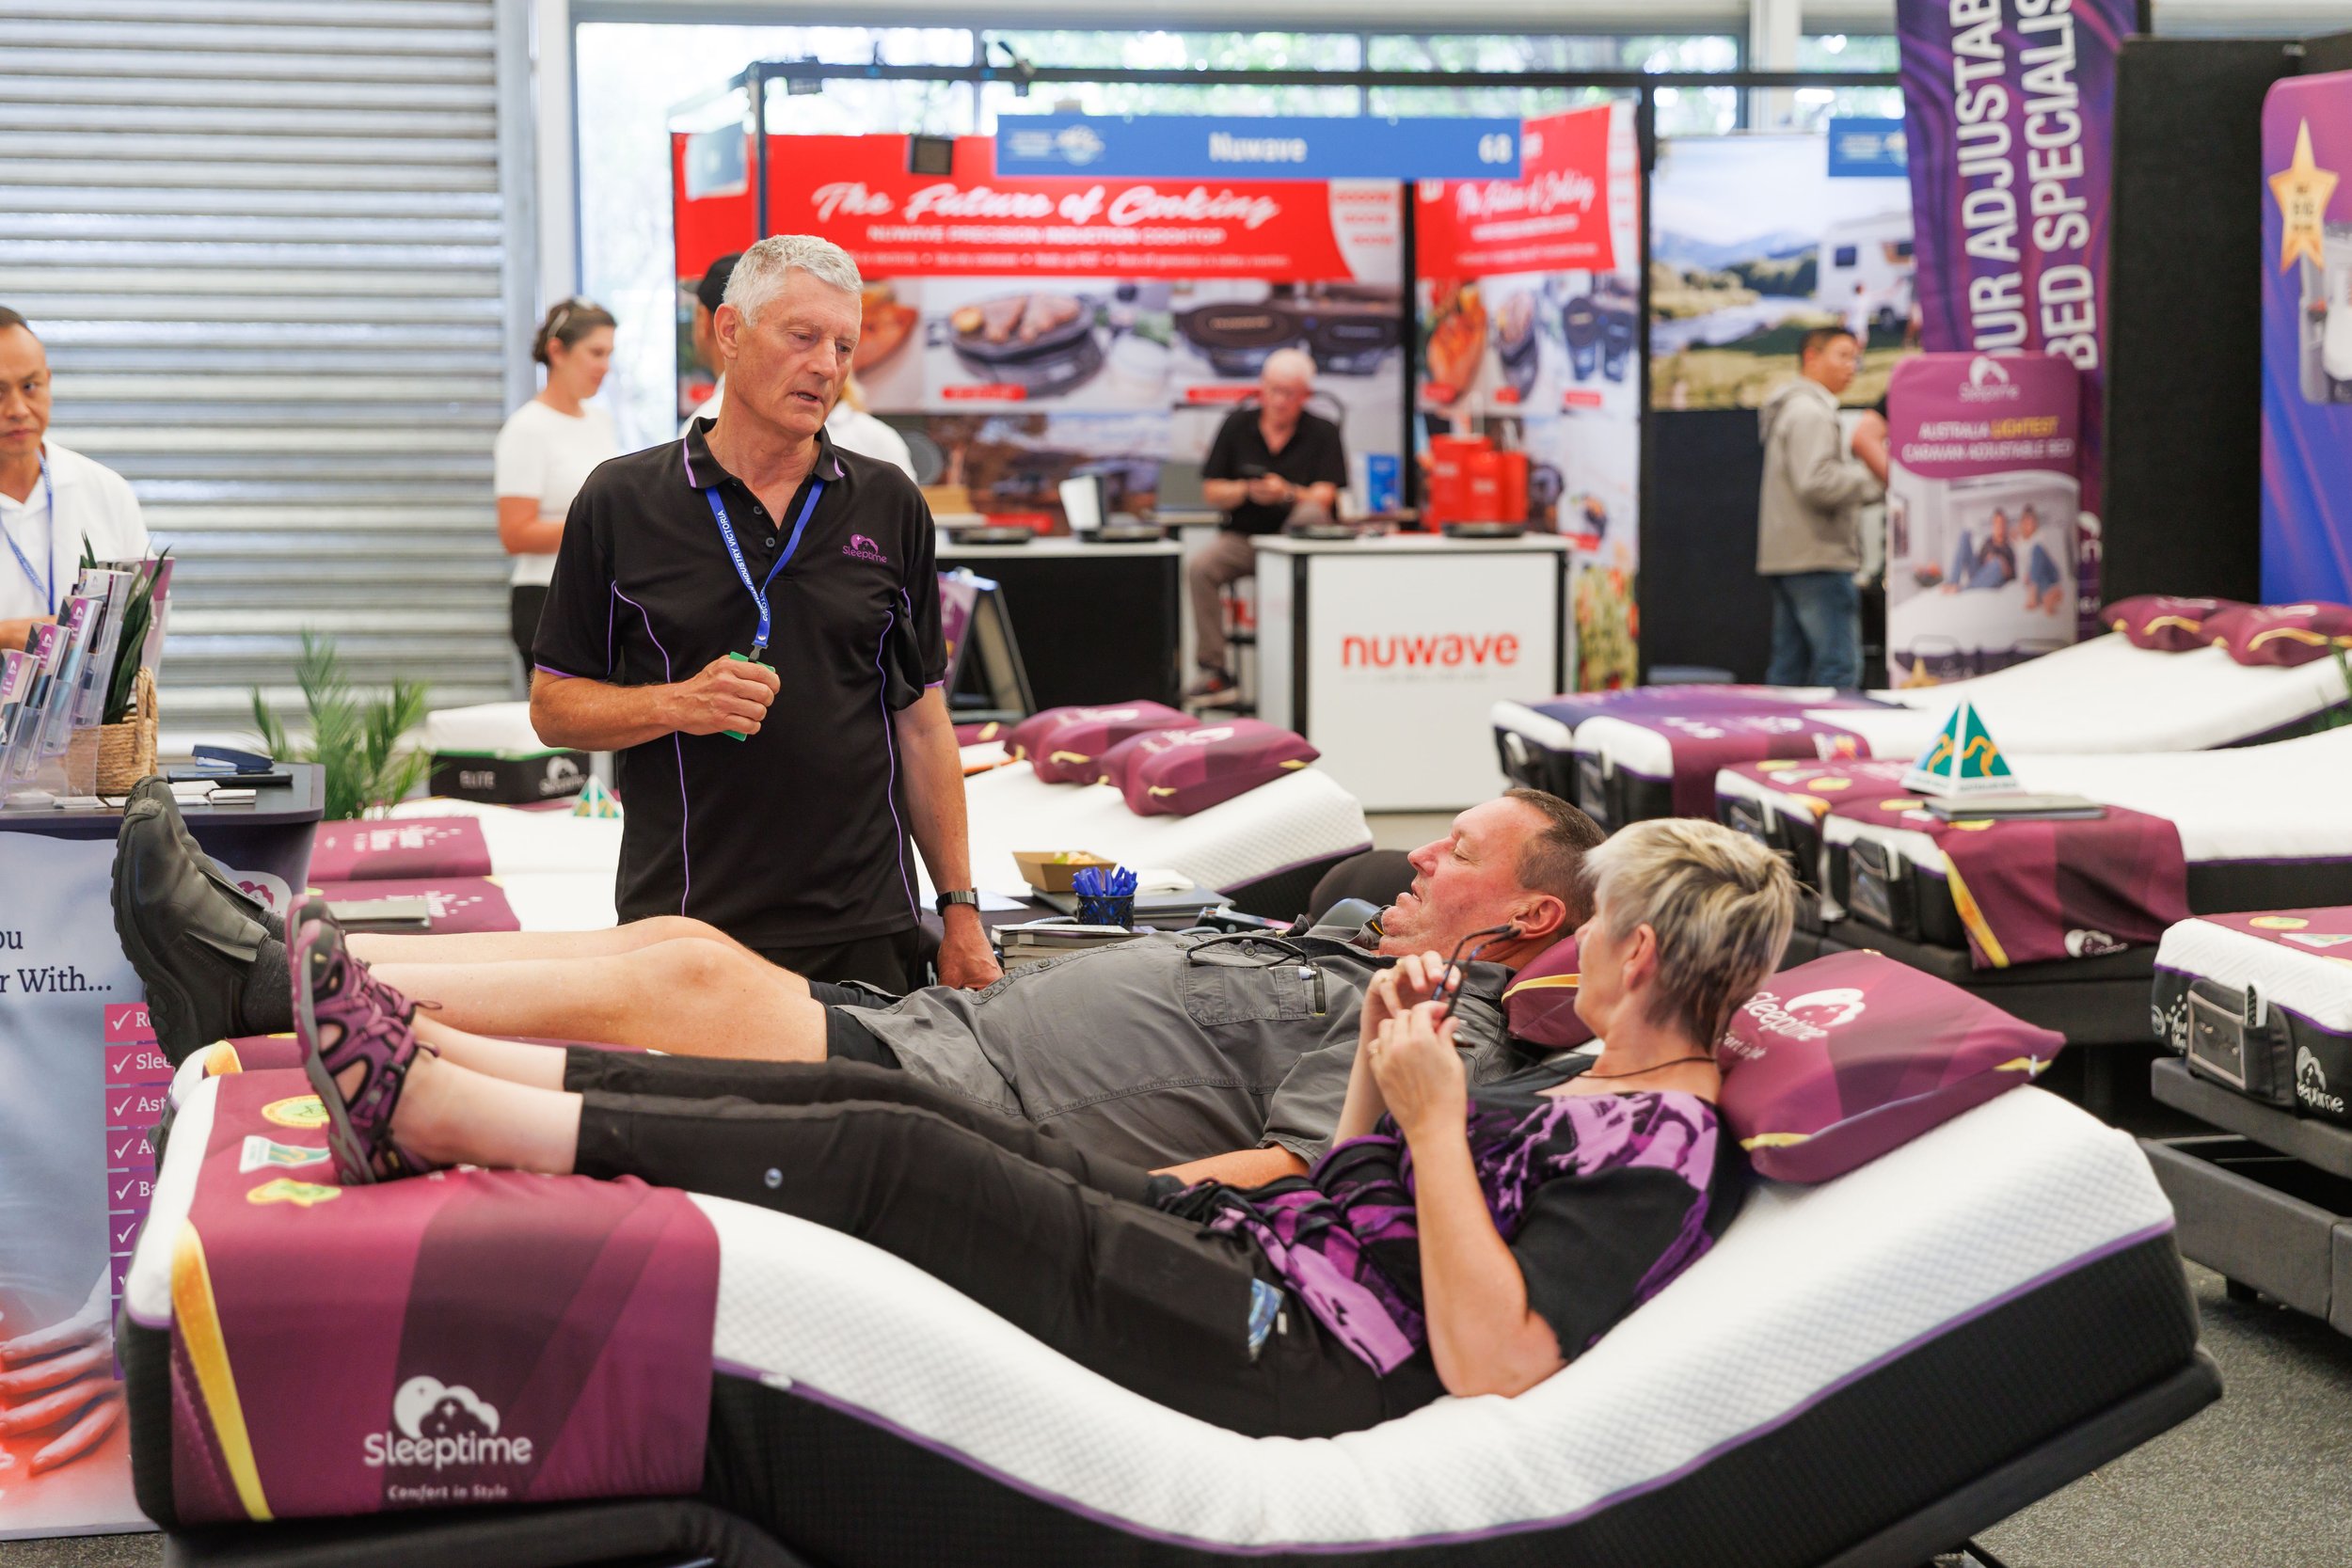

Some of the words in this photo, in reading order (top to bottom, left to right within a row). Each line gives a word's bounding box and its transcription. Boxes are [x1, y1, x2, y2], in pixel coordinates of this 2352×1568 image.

[1209, 132, 1308, 163] Nuwave
[1478, 134, 1513, 164] 68
[1058, 184, 1105, 225] of
[1107, 185, 1281, 230] Cooking
[717, 509, 737, 546] VICTORIA
[731, 547, 753, 585] INDUSTRY
[842, 545, 888, 563] Sleeptime
[1341, 632, 1520, 669] nuwave
[363, 1431, 533, 1471] Sleeptime
[387, 1484, 449, 1500] Comfort
[453, 1484, 469, 1498] in
[472, 1483, 509, 1498] Style
